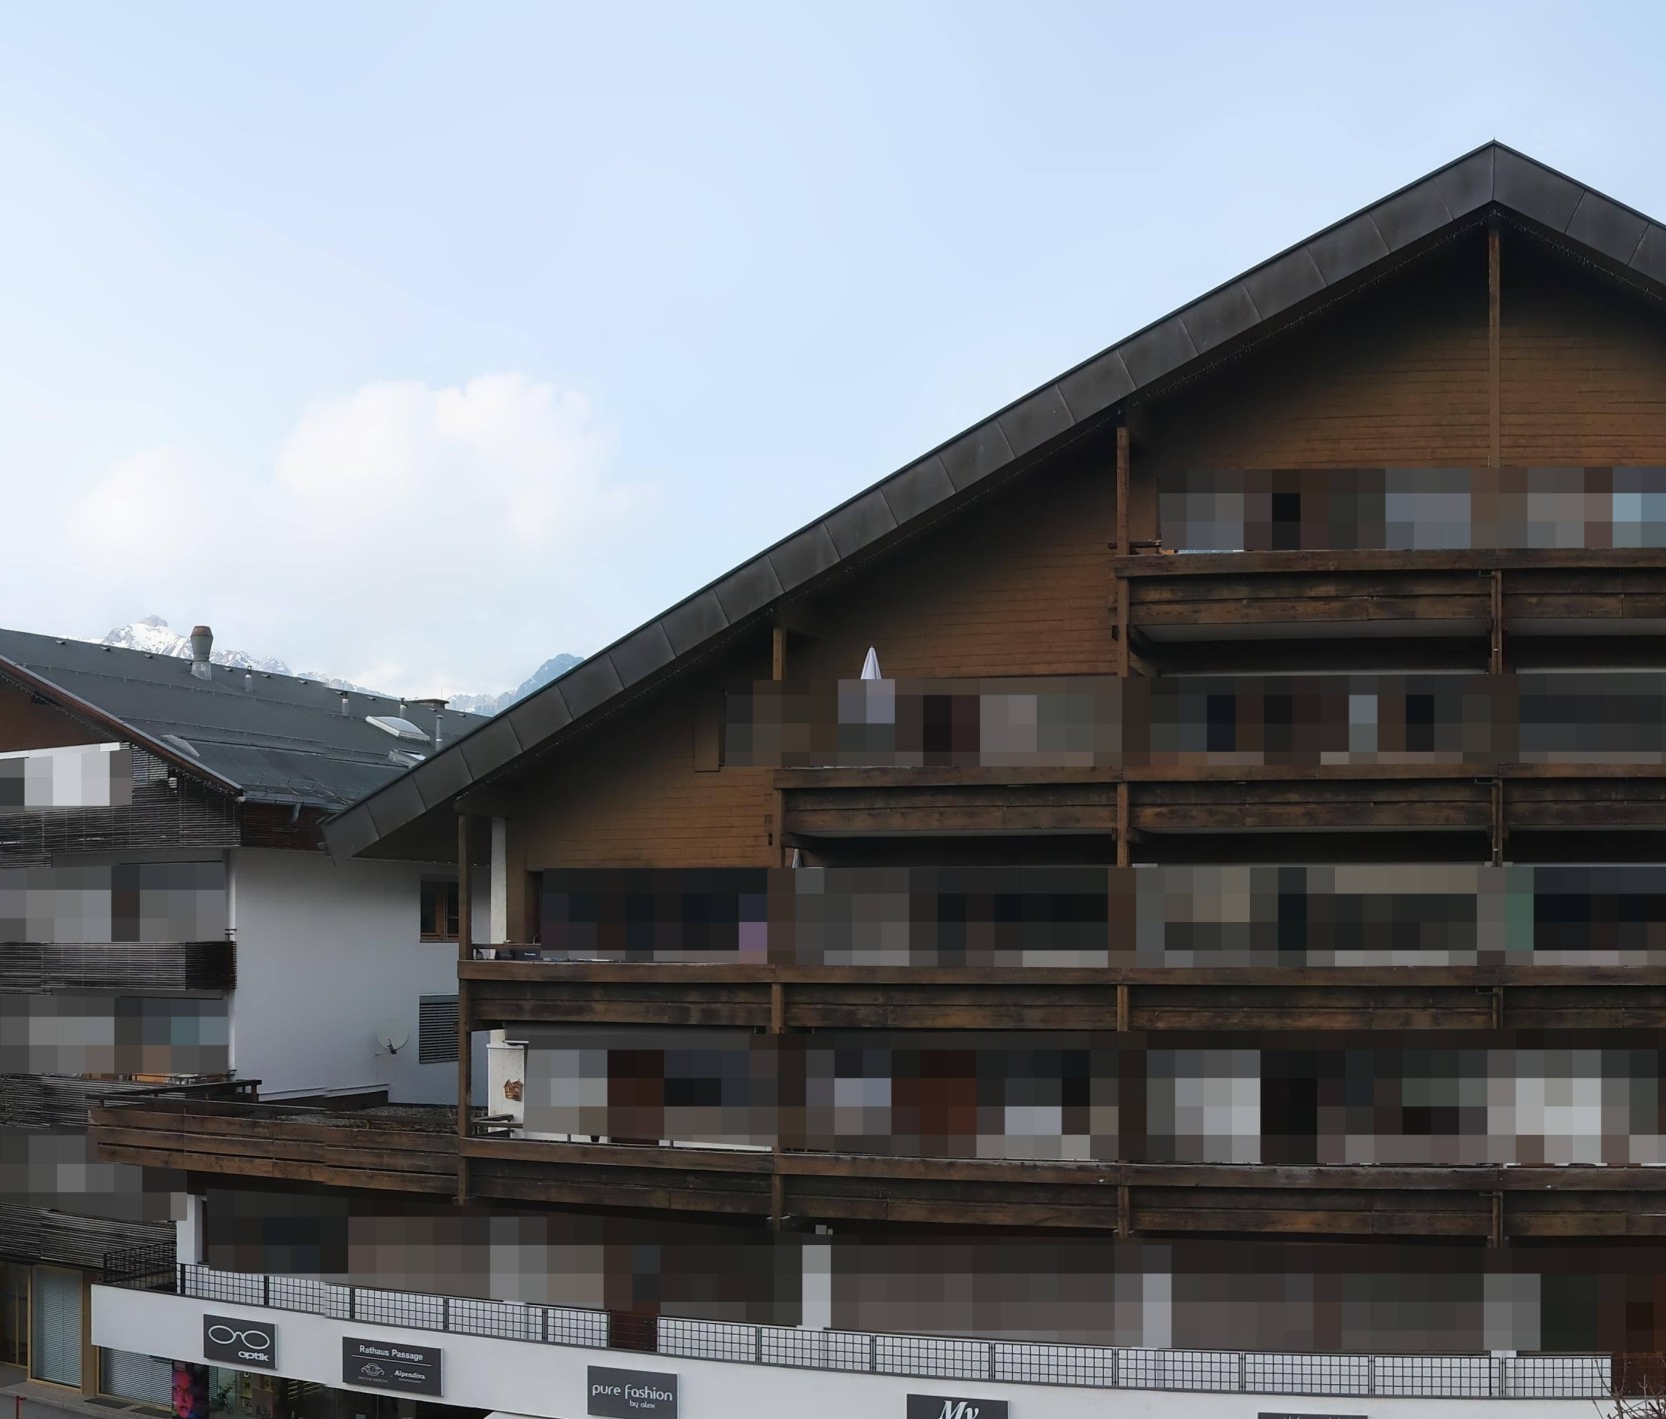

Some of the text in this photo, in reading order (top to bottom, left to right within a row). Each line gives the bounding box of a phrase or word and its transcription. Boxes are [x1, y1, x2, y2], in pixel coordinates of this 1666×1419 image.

[238, 1350, 269, 1362] optik
[359, 1344, 423, 1361] Rathaus Passage
[592, 1384, 672, 1401] pure fashion
[629, 1399, 638, 1408] by
